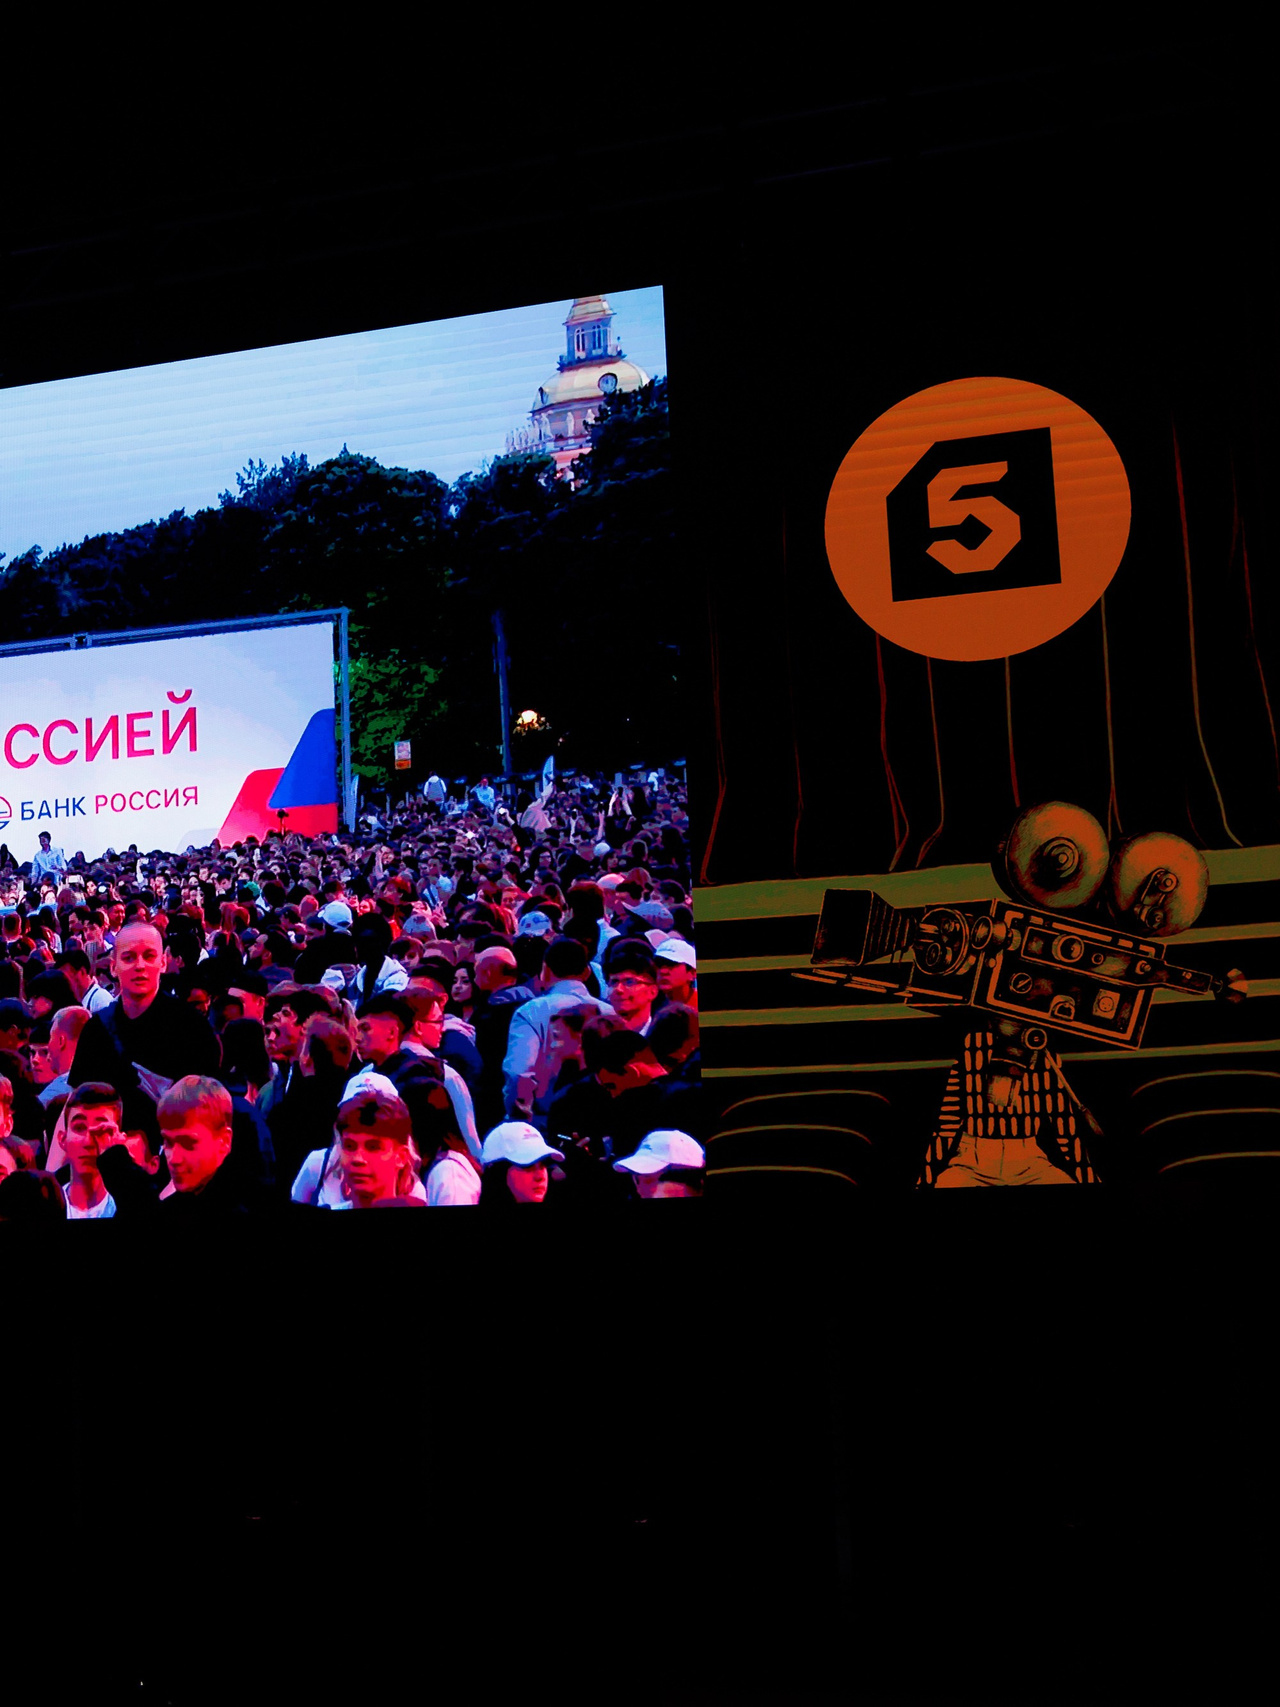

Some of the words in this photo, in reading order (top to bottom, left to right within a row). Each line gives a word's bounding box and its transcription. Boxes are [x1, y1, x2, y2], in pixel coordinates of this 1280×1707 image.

[925, 461, 1021, 574] 5
[21, 796, 86, 821] БАНК
[95, 786, 199, 814] РОССИЯ
